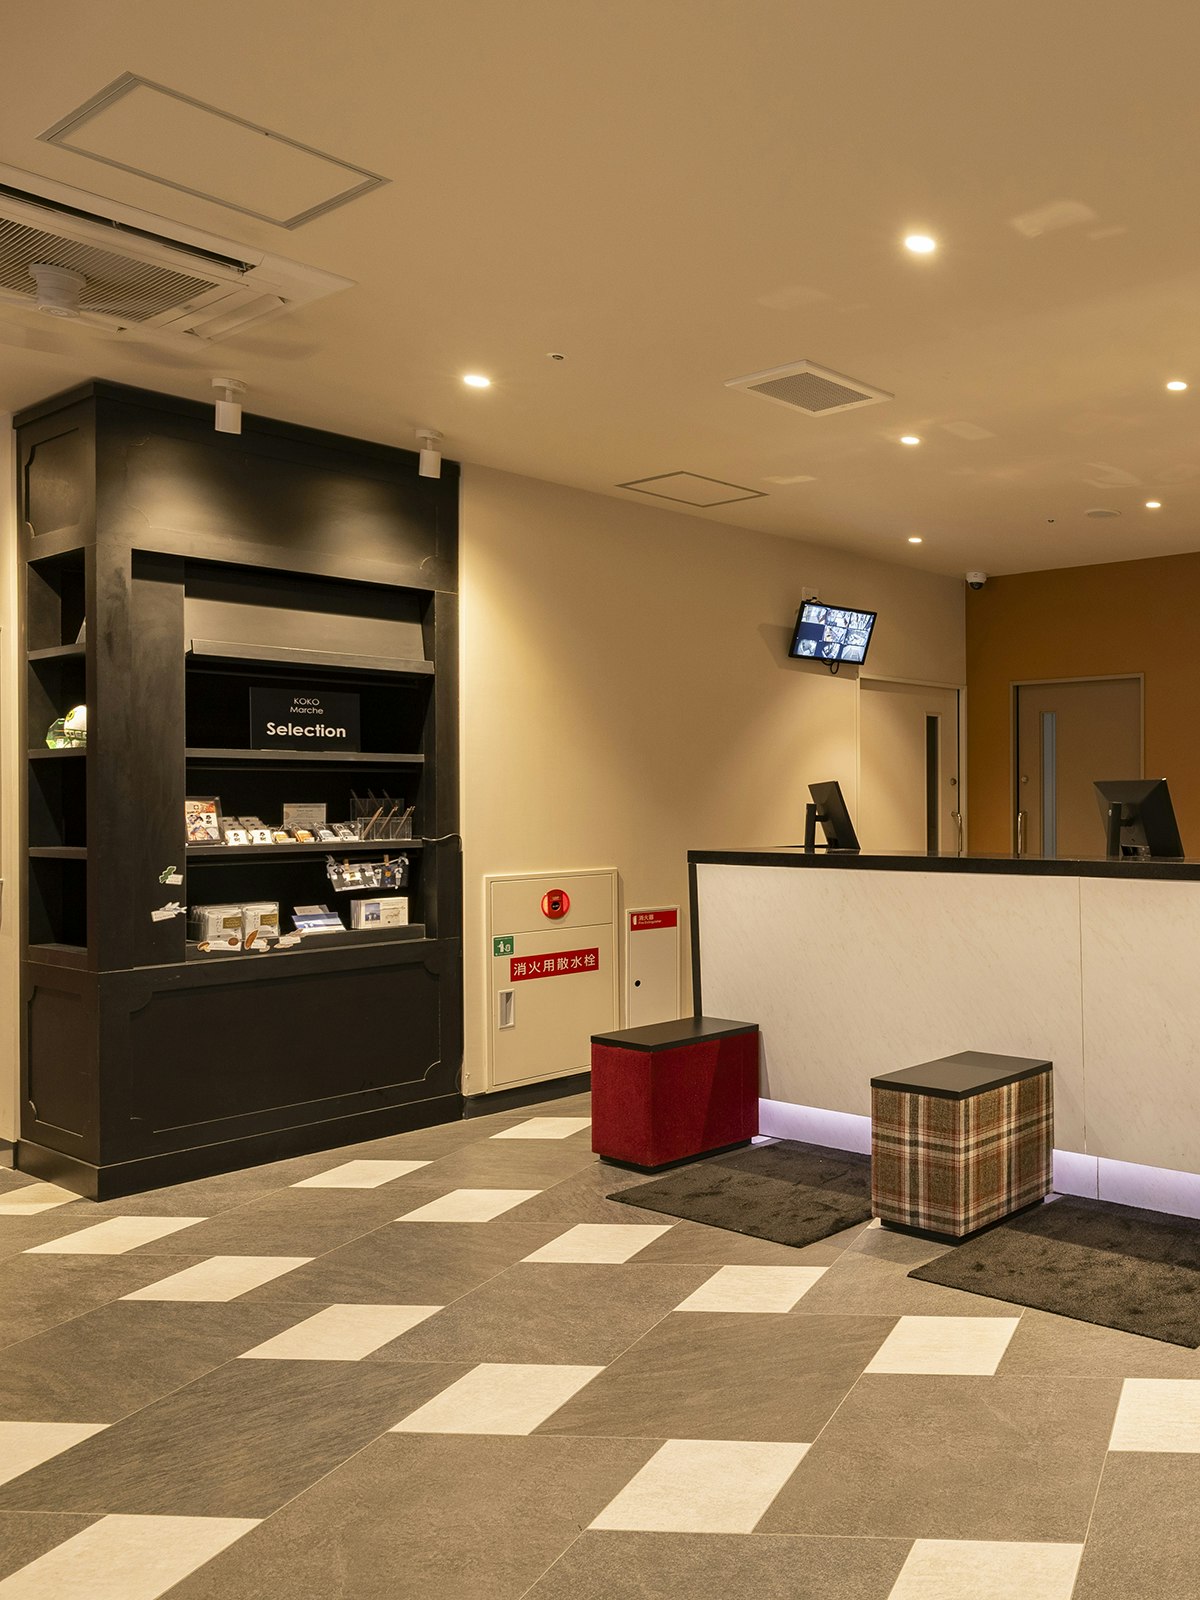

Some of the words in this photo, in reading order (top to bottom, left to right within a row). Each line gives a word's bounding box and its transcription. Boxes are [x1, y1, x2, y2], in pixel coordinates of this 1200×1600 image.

[293, 697, 320, 706] KOKO
[289, 706, 324, 715] Marche
[266, 721, 347, 738] Selection
[513, 953, 596, 976] 消火用散水栓
